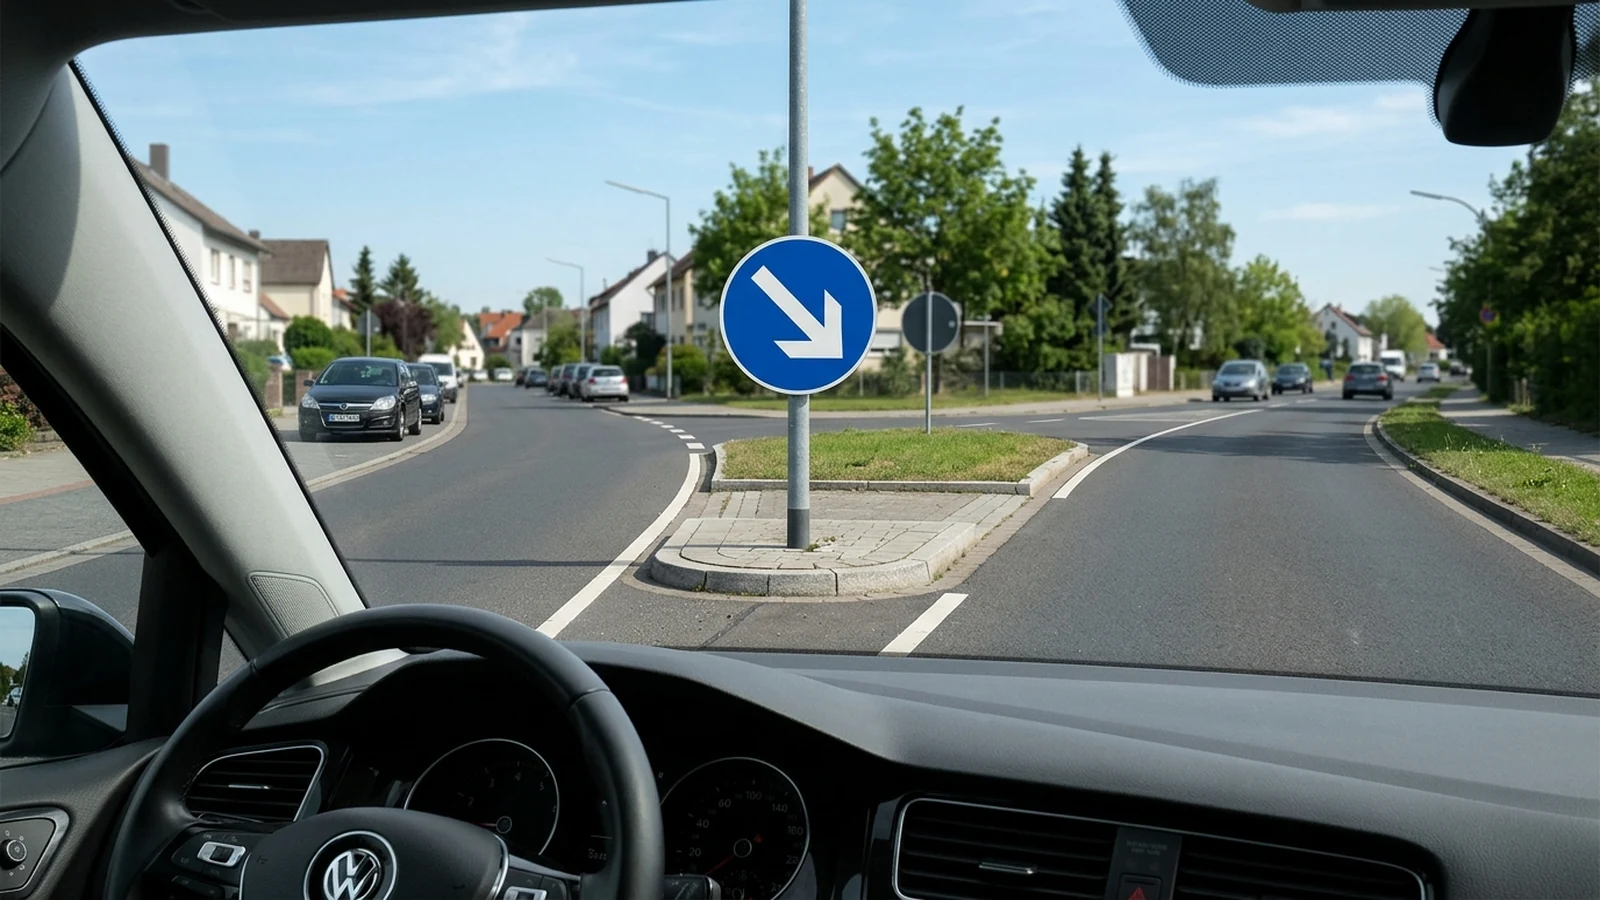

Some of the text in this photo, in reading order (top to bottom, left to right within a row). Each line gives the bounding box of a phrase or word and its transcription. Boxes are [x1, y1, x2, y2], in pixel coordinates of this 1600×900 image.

[745, 790, 762, 800] 100
[718, 799, 732, 808] 60
[772, 803, 788, 813] 140
[696, 819, 710, 828] 40
[689, 847, 702, 856] 20
[323, 848, 381, 900] VW
